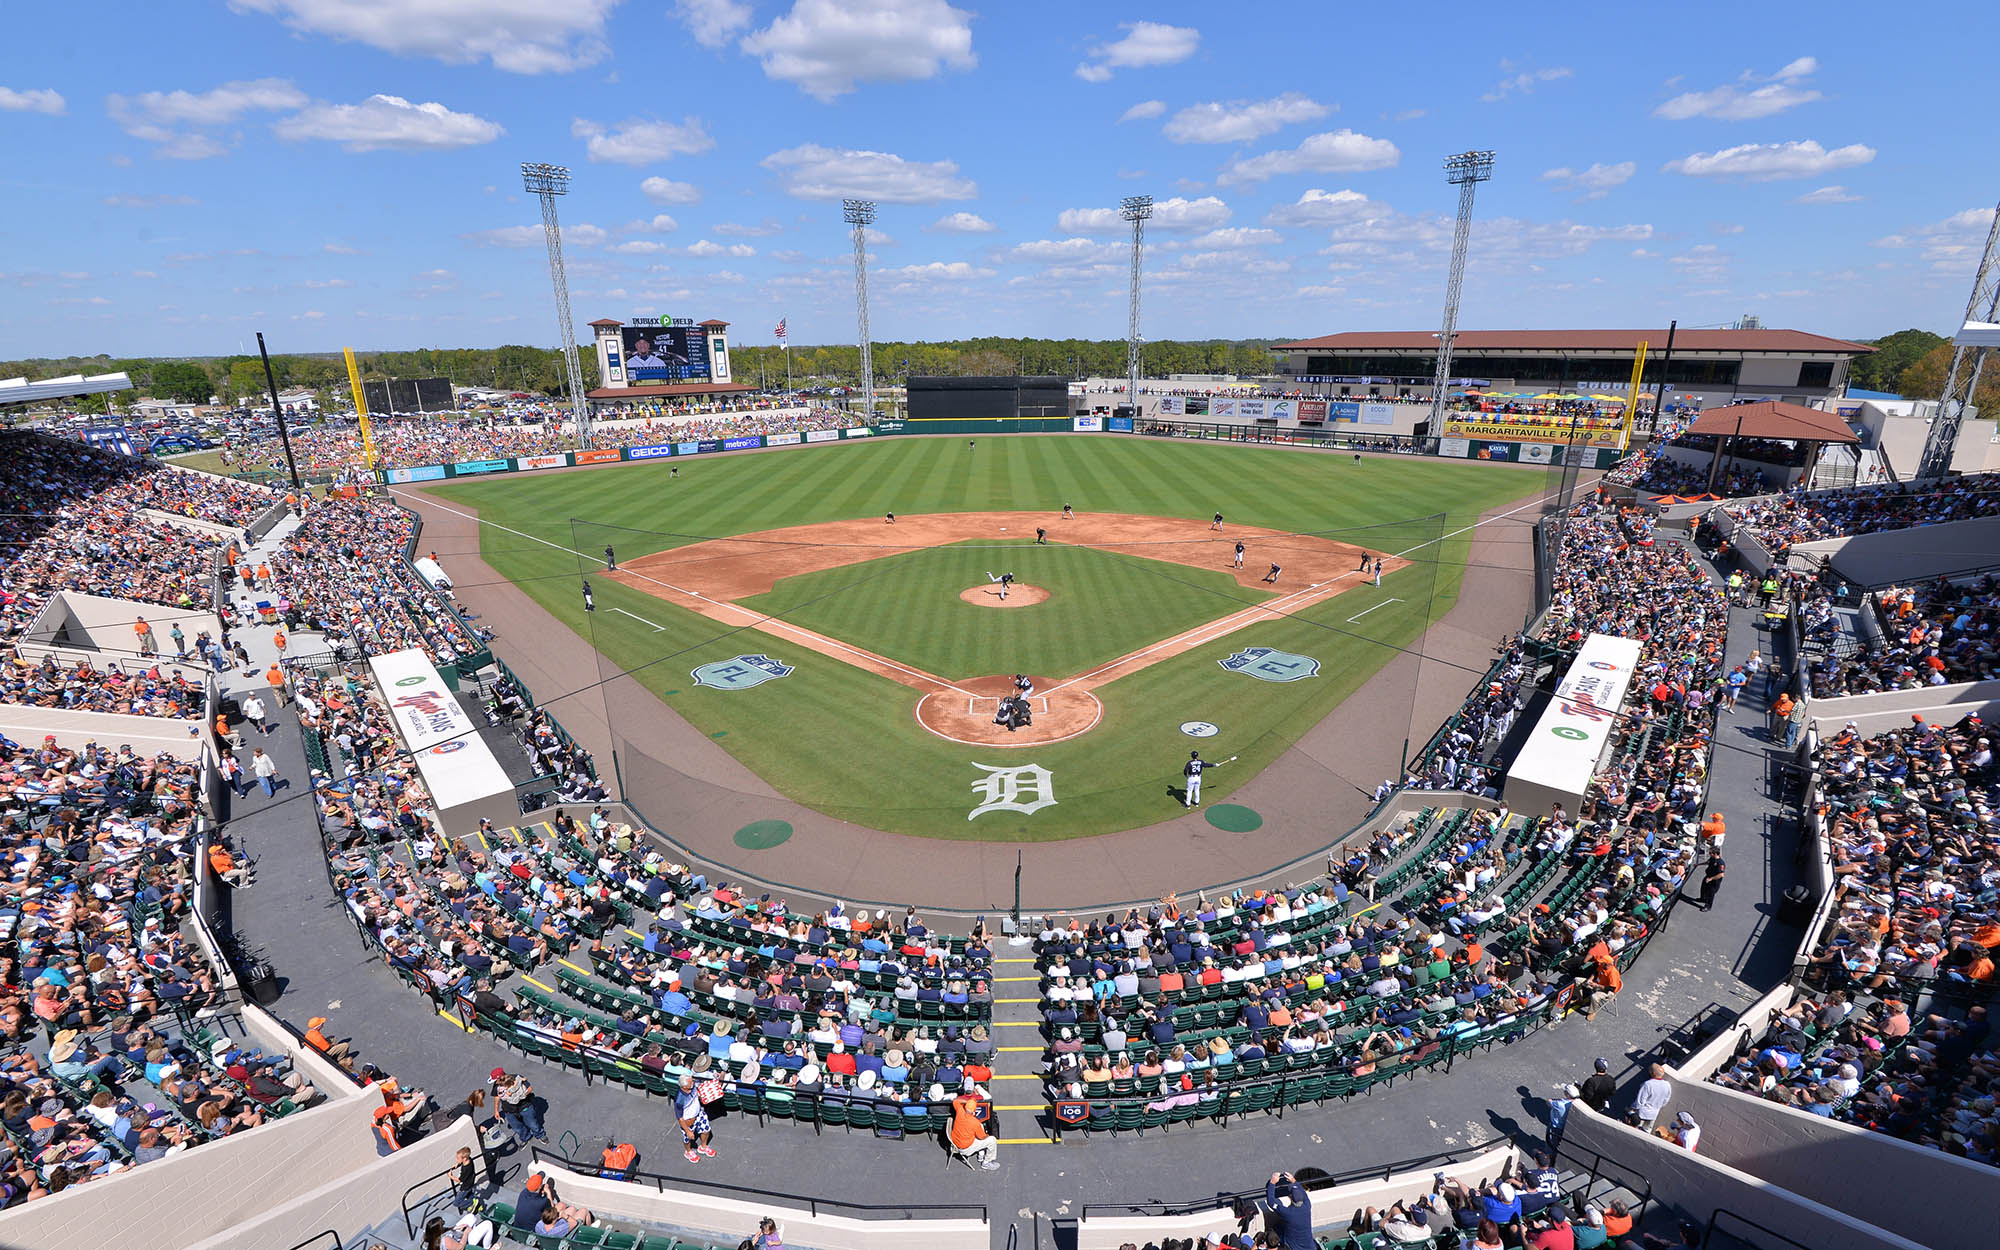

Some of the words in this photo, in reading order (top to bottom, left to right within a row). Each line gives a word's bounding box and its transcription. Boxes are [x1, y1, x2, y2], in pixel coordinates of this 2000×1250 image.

[658, 345, 667, 353] 41
[1466, 426, 1557, 437] MARGARITAVILLE
[725, 438, 760, 449] metroPCS
[630, 446, 669, 458] GEICO
[527, 457, 557, 467] HOOTERS
[711, 665, 749, 682] FL
[1257, 661, 1300, 675] FL
[1575, 675, 1601, 693] FANS
[426, 712, 456, 733] FANS
[1192, 765, 1201, 773] 24
[1537, 1181, 1560, 1198] 24
